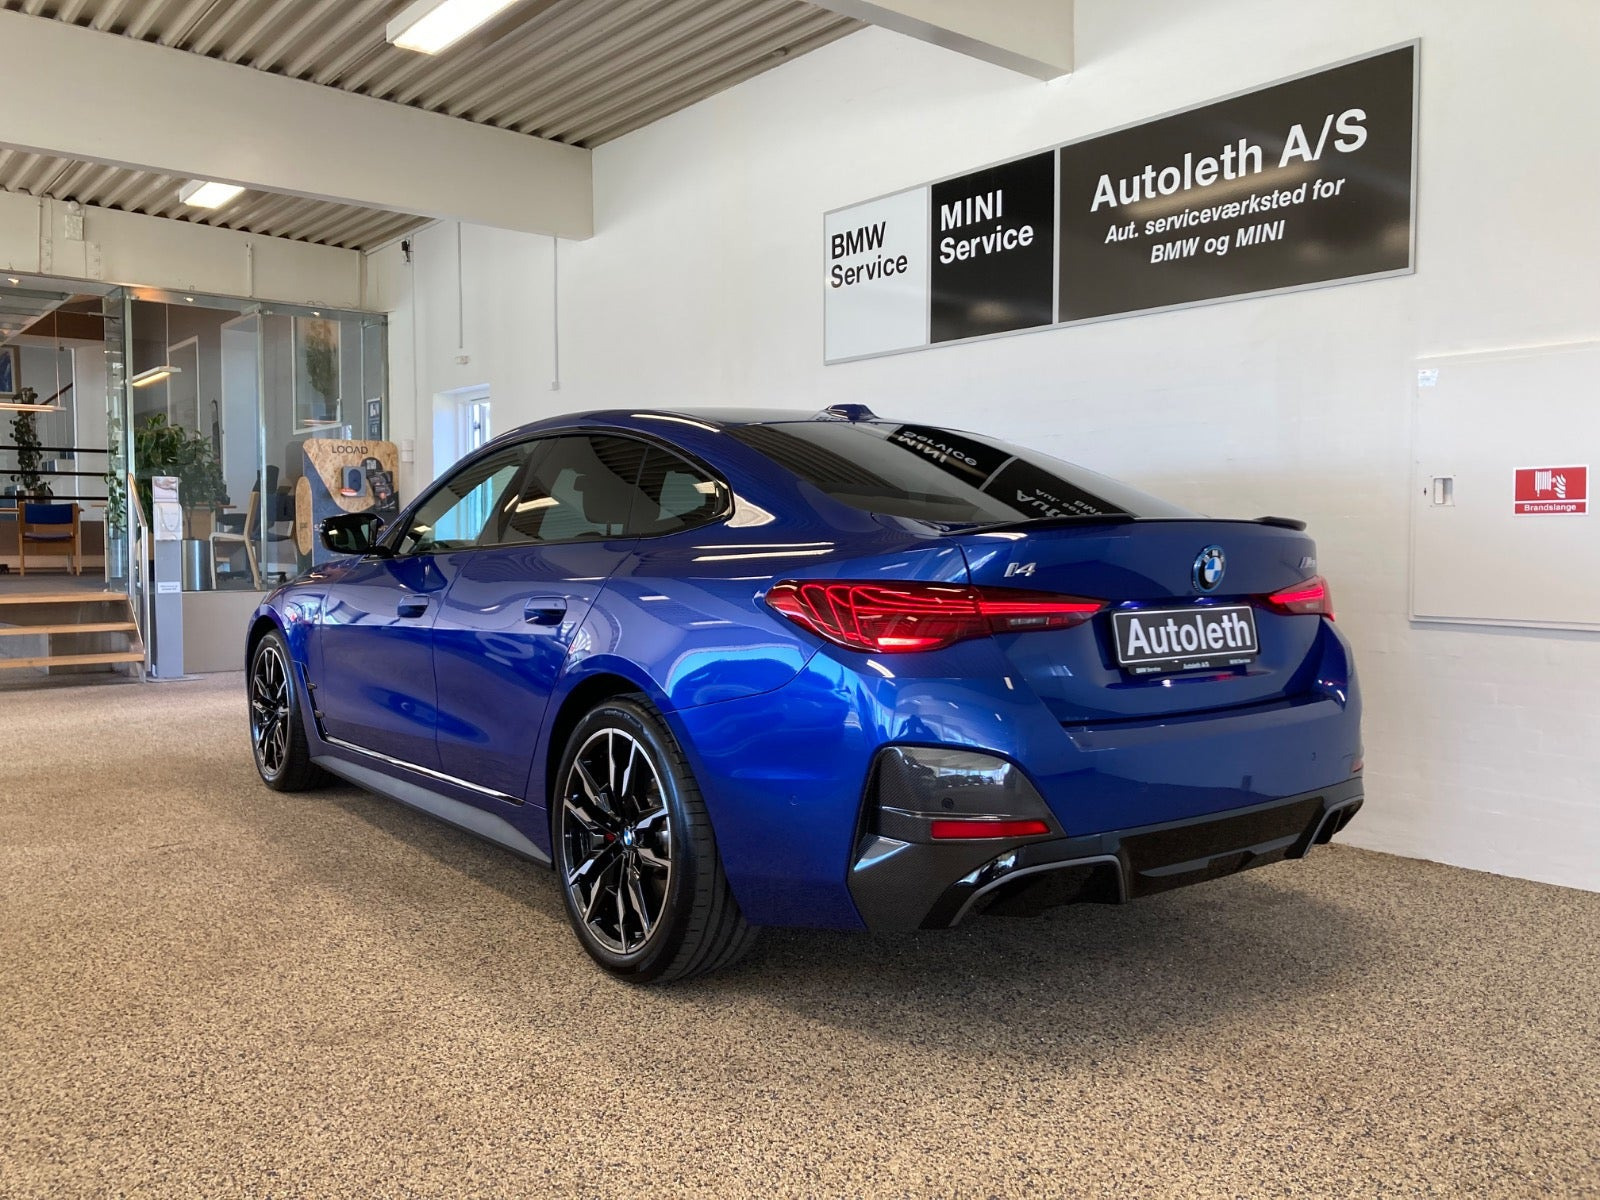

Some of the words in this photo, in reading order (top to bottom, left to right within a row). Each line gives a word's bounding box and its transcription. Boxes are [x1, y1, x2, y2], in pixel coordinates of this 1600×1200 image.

[1090, 138, 1263, 213] Autoleth
[1278, 108, 1368, 168] A/S
[940, 189, 1003, 231] MINI
[1104, 220, 1139, 244] Aut.
[1144, 182, 1307, 235] serviceværksted
[1312, 177, 1346, 201] for
[831, 221, 886, 260] BMW
[939, 225, 1034, 265] Service
[1150, 236, 1200, 264] BMW
[1204, 234, 1230, 256] og
[1235, 219, 1286, 248] MINI
[830, 254, 908, 288] Service
[1524, 503, 1577, 512] Brandslange
[1126, 611, 1252, 656] Autoleth
